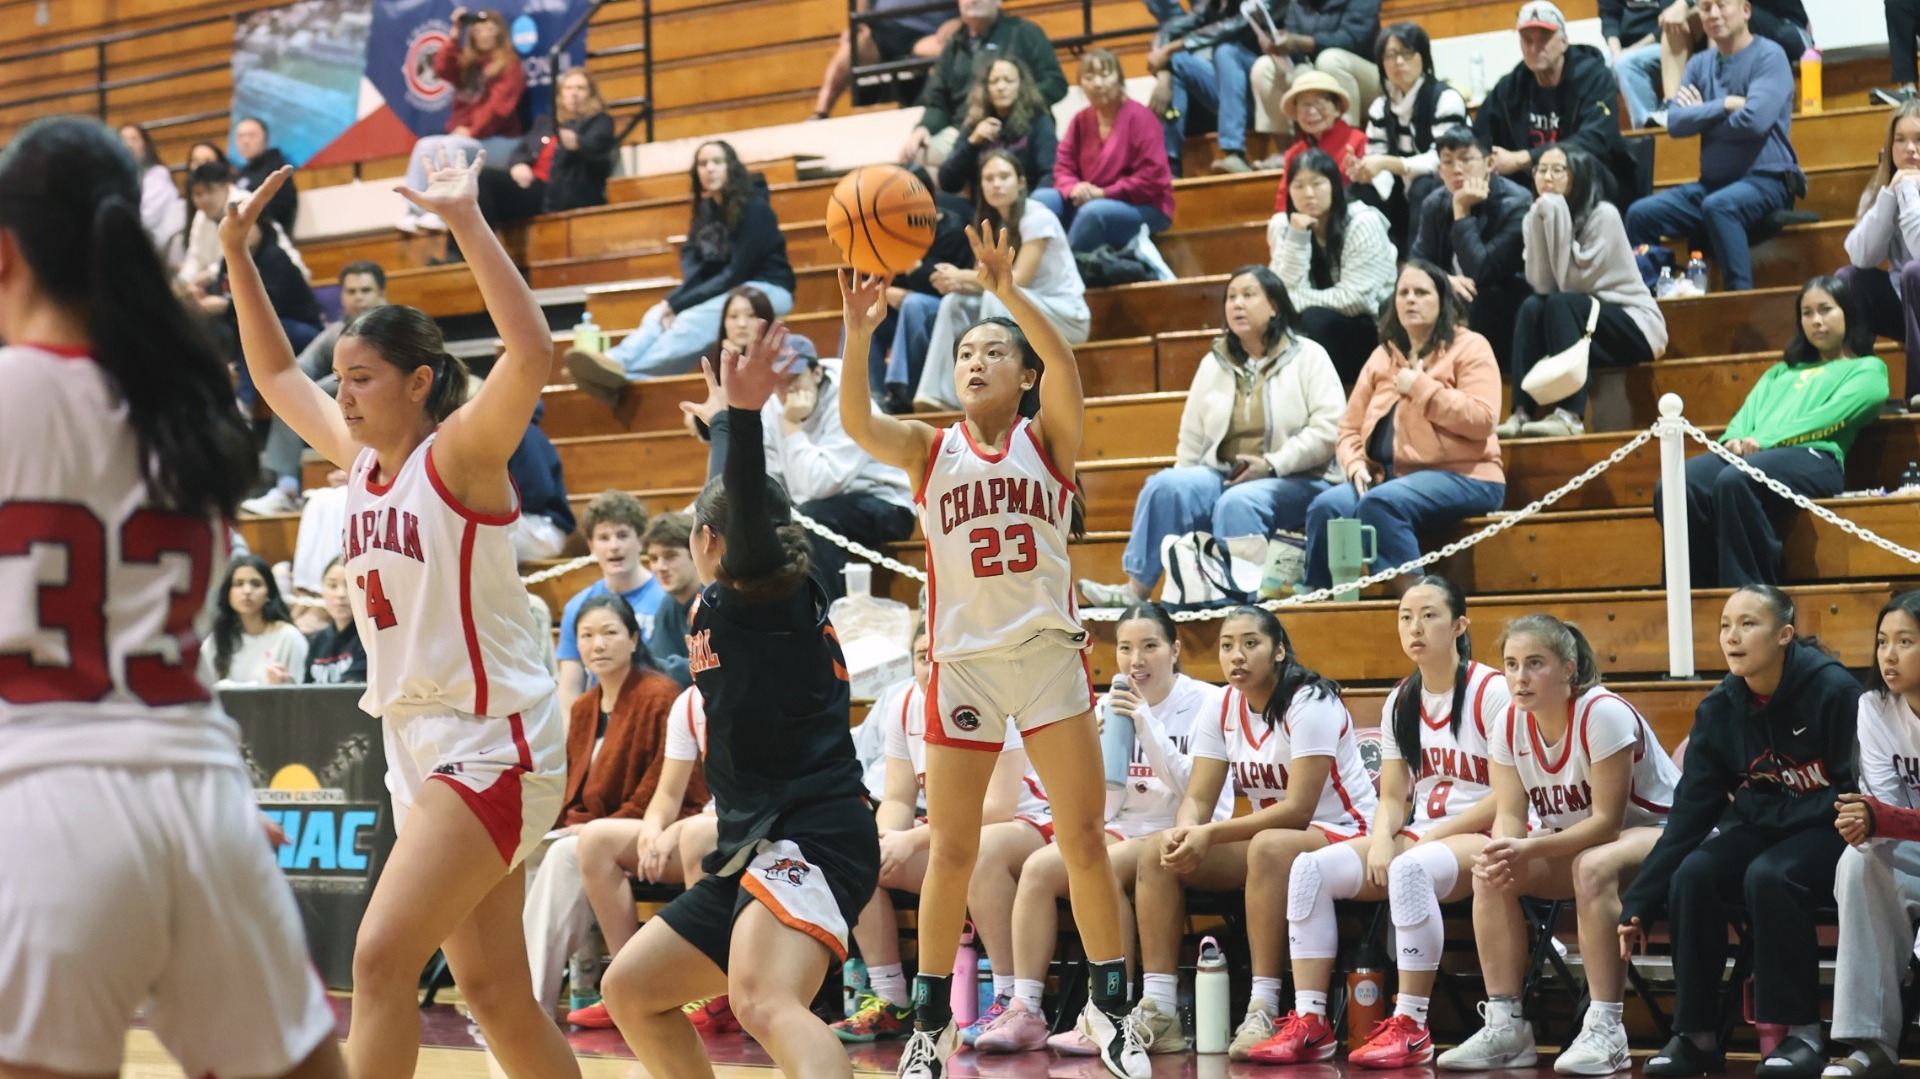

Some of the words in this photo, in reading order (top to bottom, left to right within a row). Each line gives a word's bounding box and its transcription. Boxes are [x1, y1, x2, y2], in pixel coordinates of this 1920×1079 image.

[341, 507, 426, 566] APAN
[969, 522, 1038, 578] 23
[0, 499, 214, 707] 33
[1415, 747, 1490, 787] APMAN
[254, 790, 292, 801] UTHERN
[1427, 780, 1454, 819] 8
[1530, 780, 1592, 817] HAPMA
[262, 809, 377, 870] IAC
